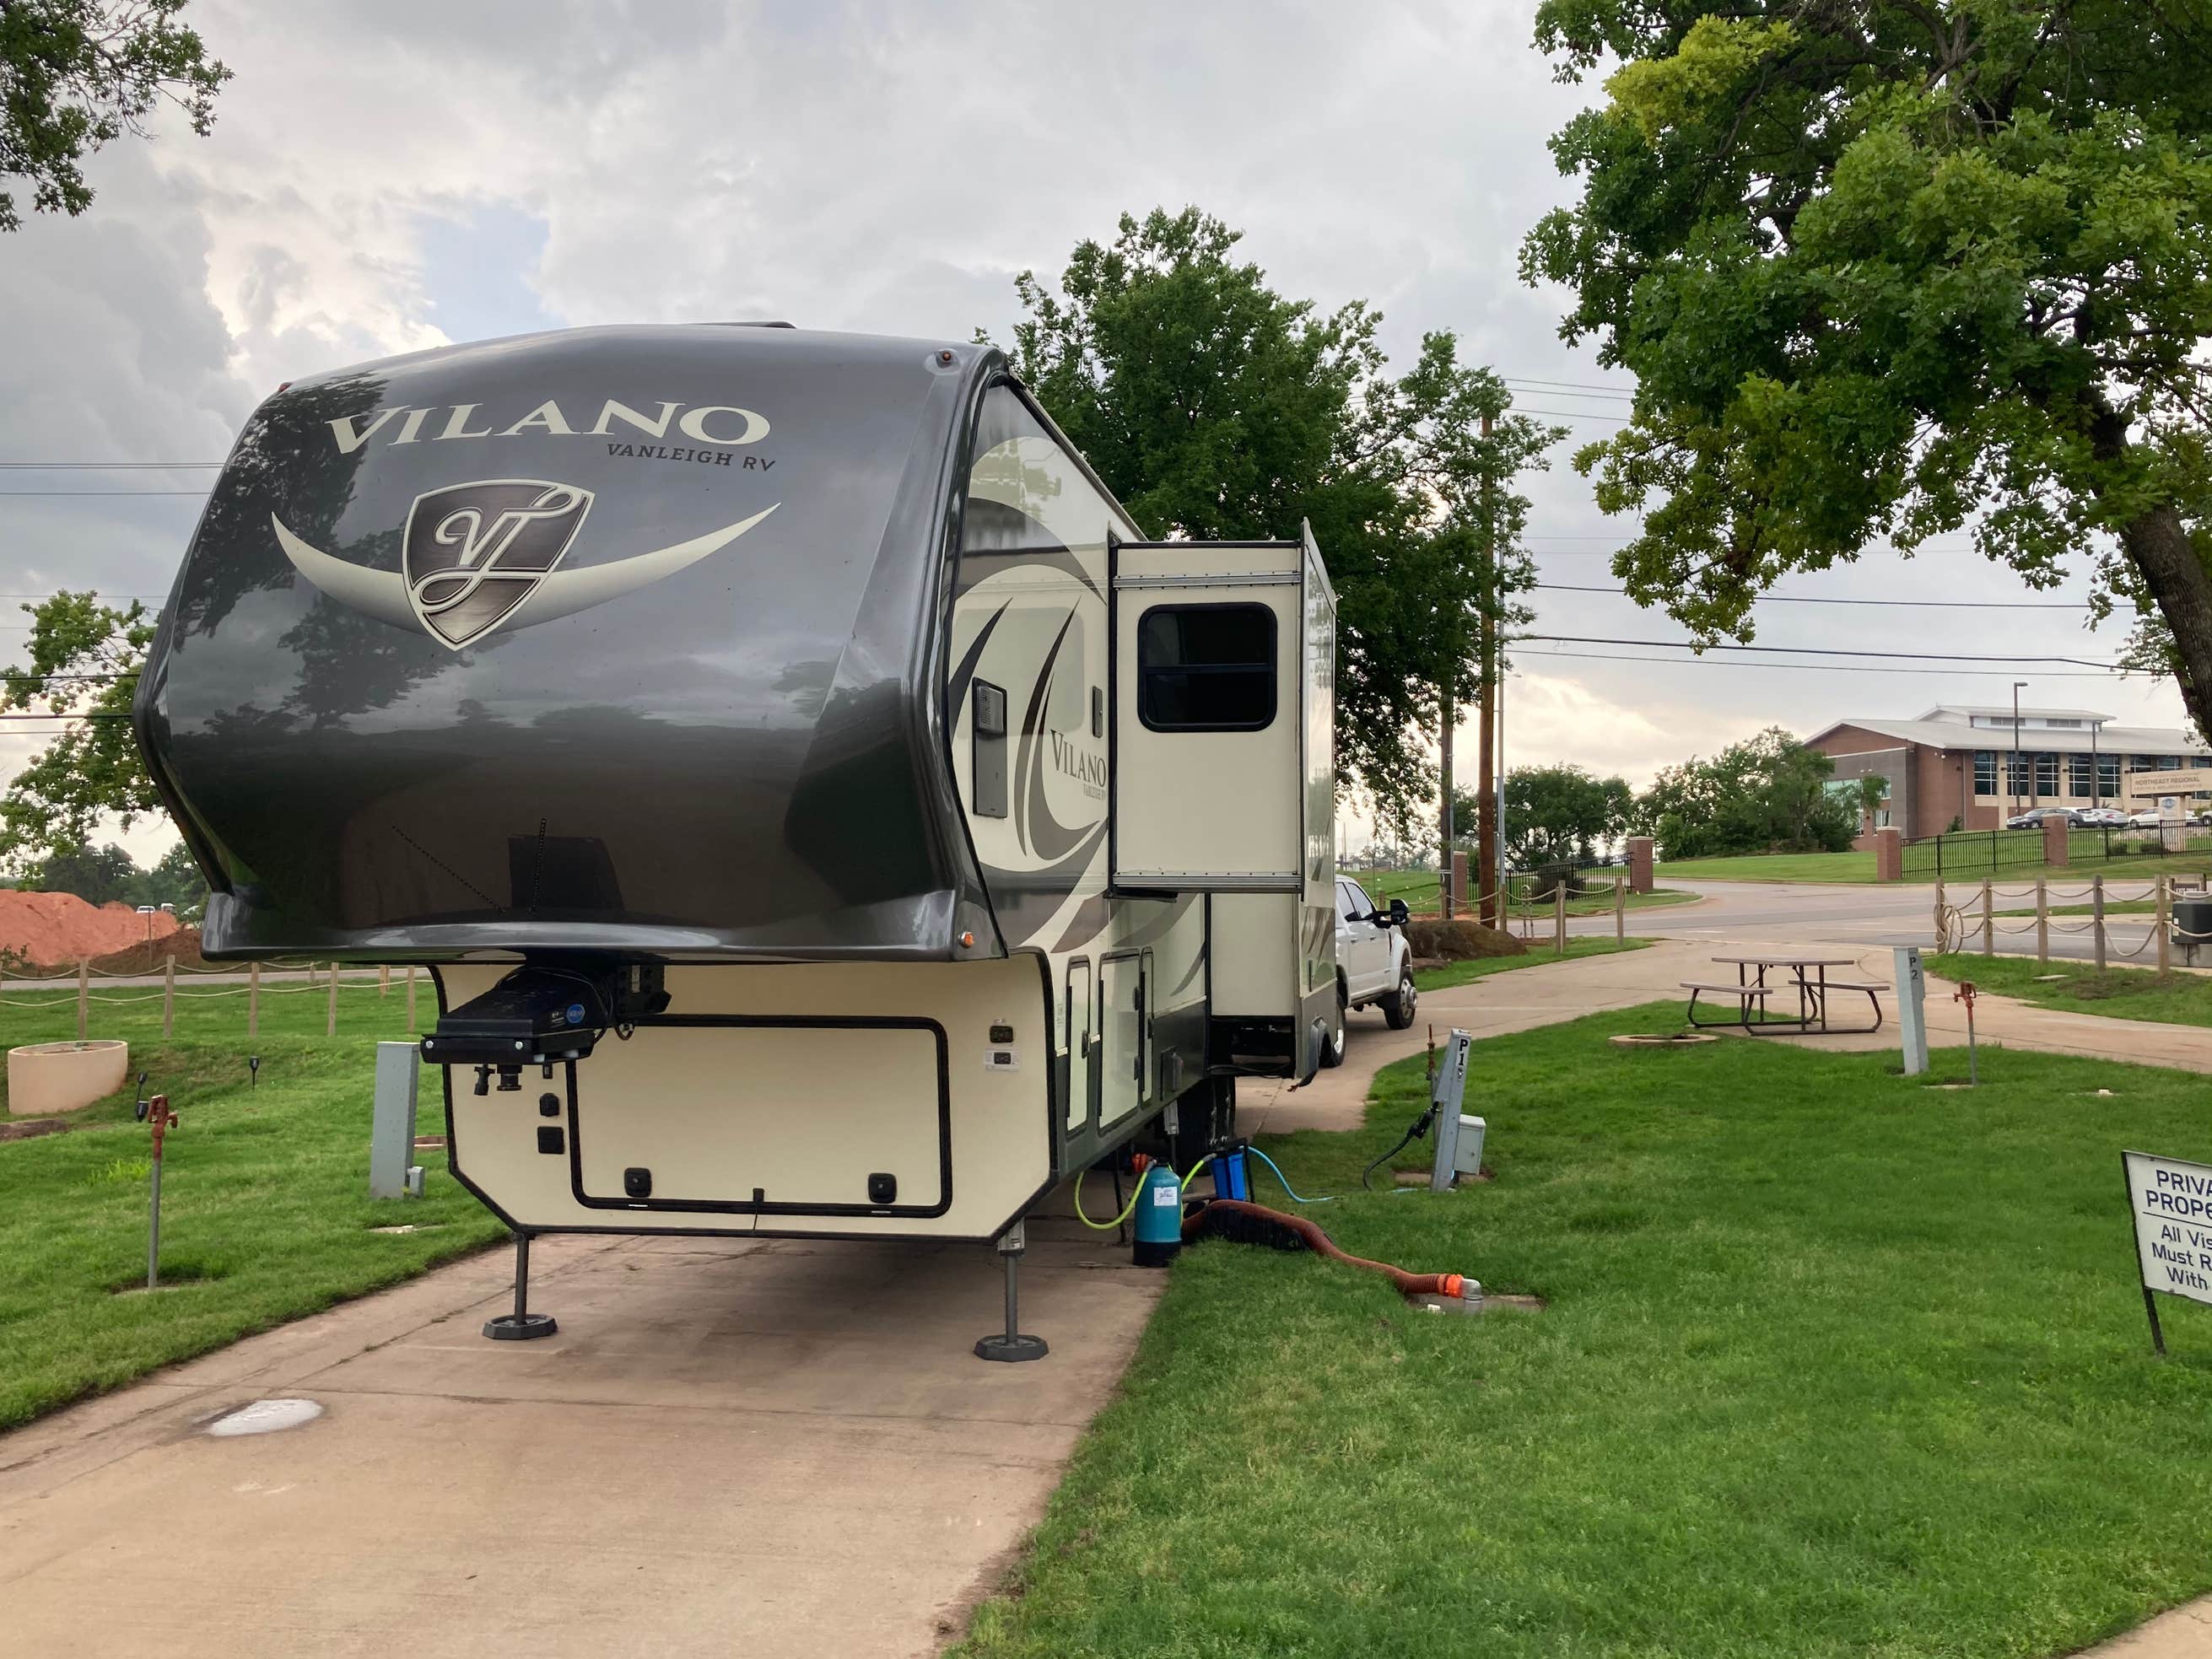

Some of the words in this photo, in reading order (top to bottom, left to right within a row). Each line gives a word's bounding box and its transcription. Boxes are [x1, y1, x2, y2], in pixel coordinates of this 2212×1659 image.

[326, 400, 770, 454] VILANO
[607, 444, 734, 466] VANLEIGH
[742, 456, 775, 472] RV
[1050, 729, 1106, 787] VILANO
[2161, 1225, 2181, 1242] All
[2152, 1242, 2193, 1267] Must
[2166, 1265, 2208, 1290] With
